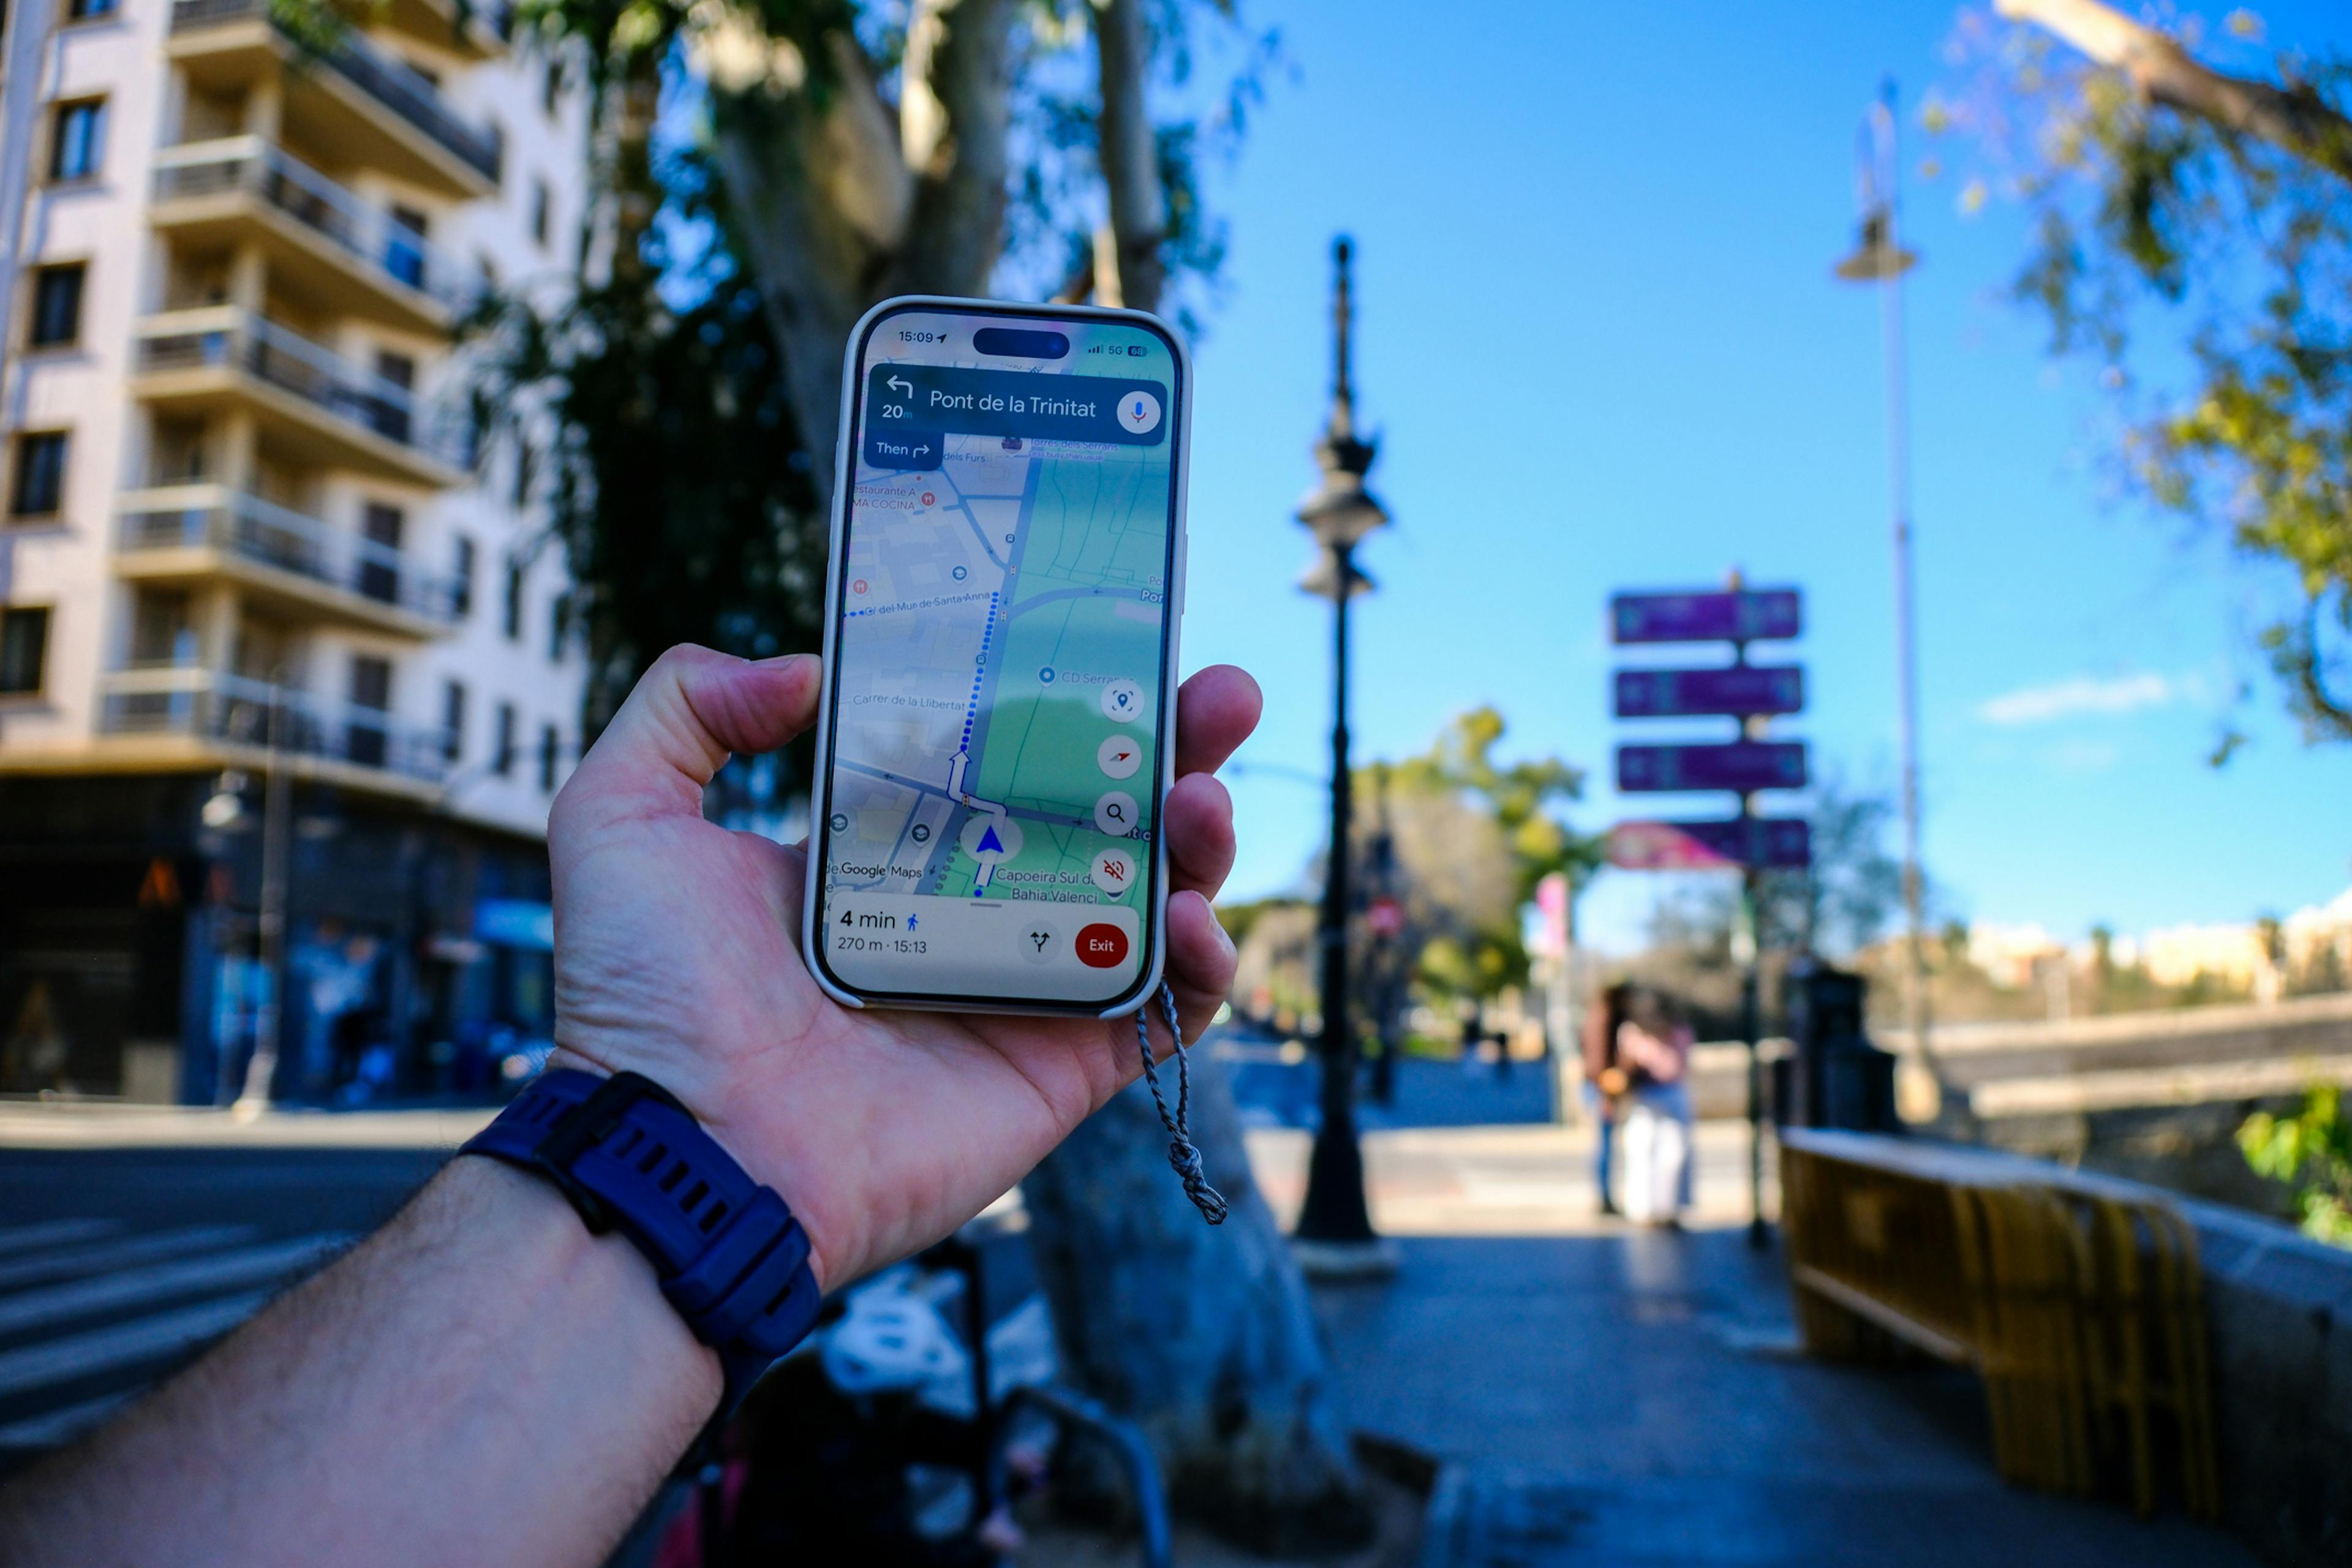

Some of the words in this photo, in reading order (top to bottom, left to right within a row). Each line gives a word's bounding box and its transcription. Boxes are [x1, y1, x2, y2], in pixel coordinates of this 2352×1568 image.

[899, 331, 933, 342] 15:09
[1109, 345, 1123, 355] 5G
[930, 390, 974, 410] Pont
[979, 394, 1005, 412] de
[1009, 395, 1025, 413] la
[1030, 396, 1096, 418] Trinitat
[876, 442, 908, 455] Then
[908, 488, 916, 496] A
[871, 499, 915, 510] COCINA
[879, 603, 894, 614] del
[919, 599, 932, 608] de
[934, 595, 962, 606] Santa
[965, 592, 990, 601] Anna
[1061, 671, 1080, 683] CD
[853, 694, 888, 705] Carrer
[891, 695, 905, 706] de
[908, 696, 918, 707] la
[920, 698, 966, 711] Llibertat
[842, 862, 886, 879] Google
[891, 865, 922, 880] Maps
[996, 868, 1056, 883] Capoeira
[1059, 871, 1079, 884] Sul
[1012, 888, 1047, 901] Bahia
[1051, 890, 1098, 904] Valenci
[840, 910, 853, 927] 4
[859, 911, 895, 929] min
[838, 937, 865, 951] 270
[869, 941, 882, 951] m
[894, 940, 927, 954] 15:13
[1089, 939, 1115, 952] Exit
